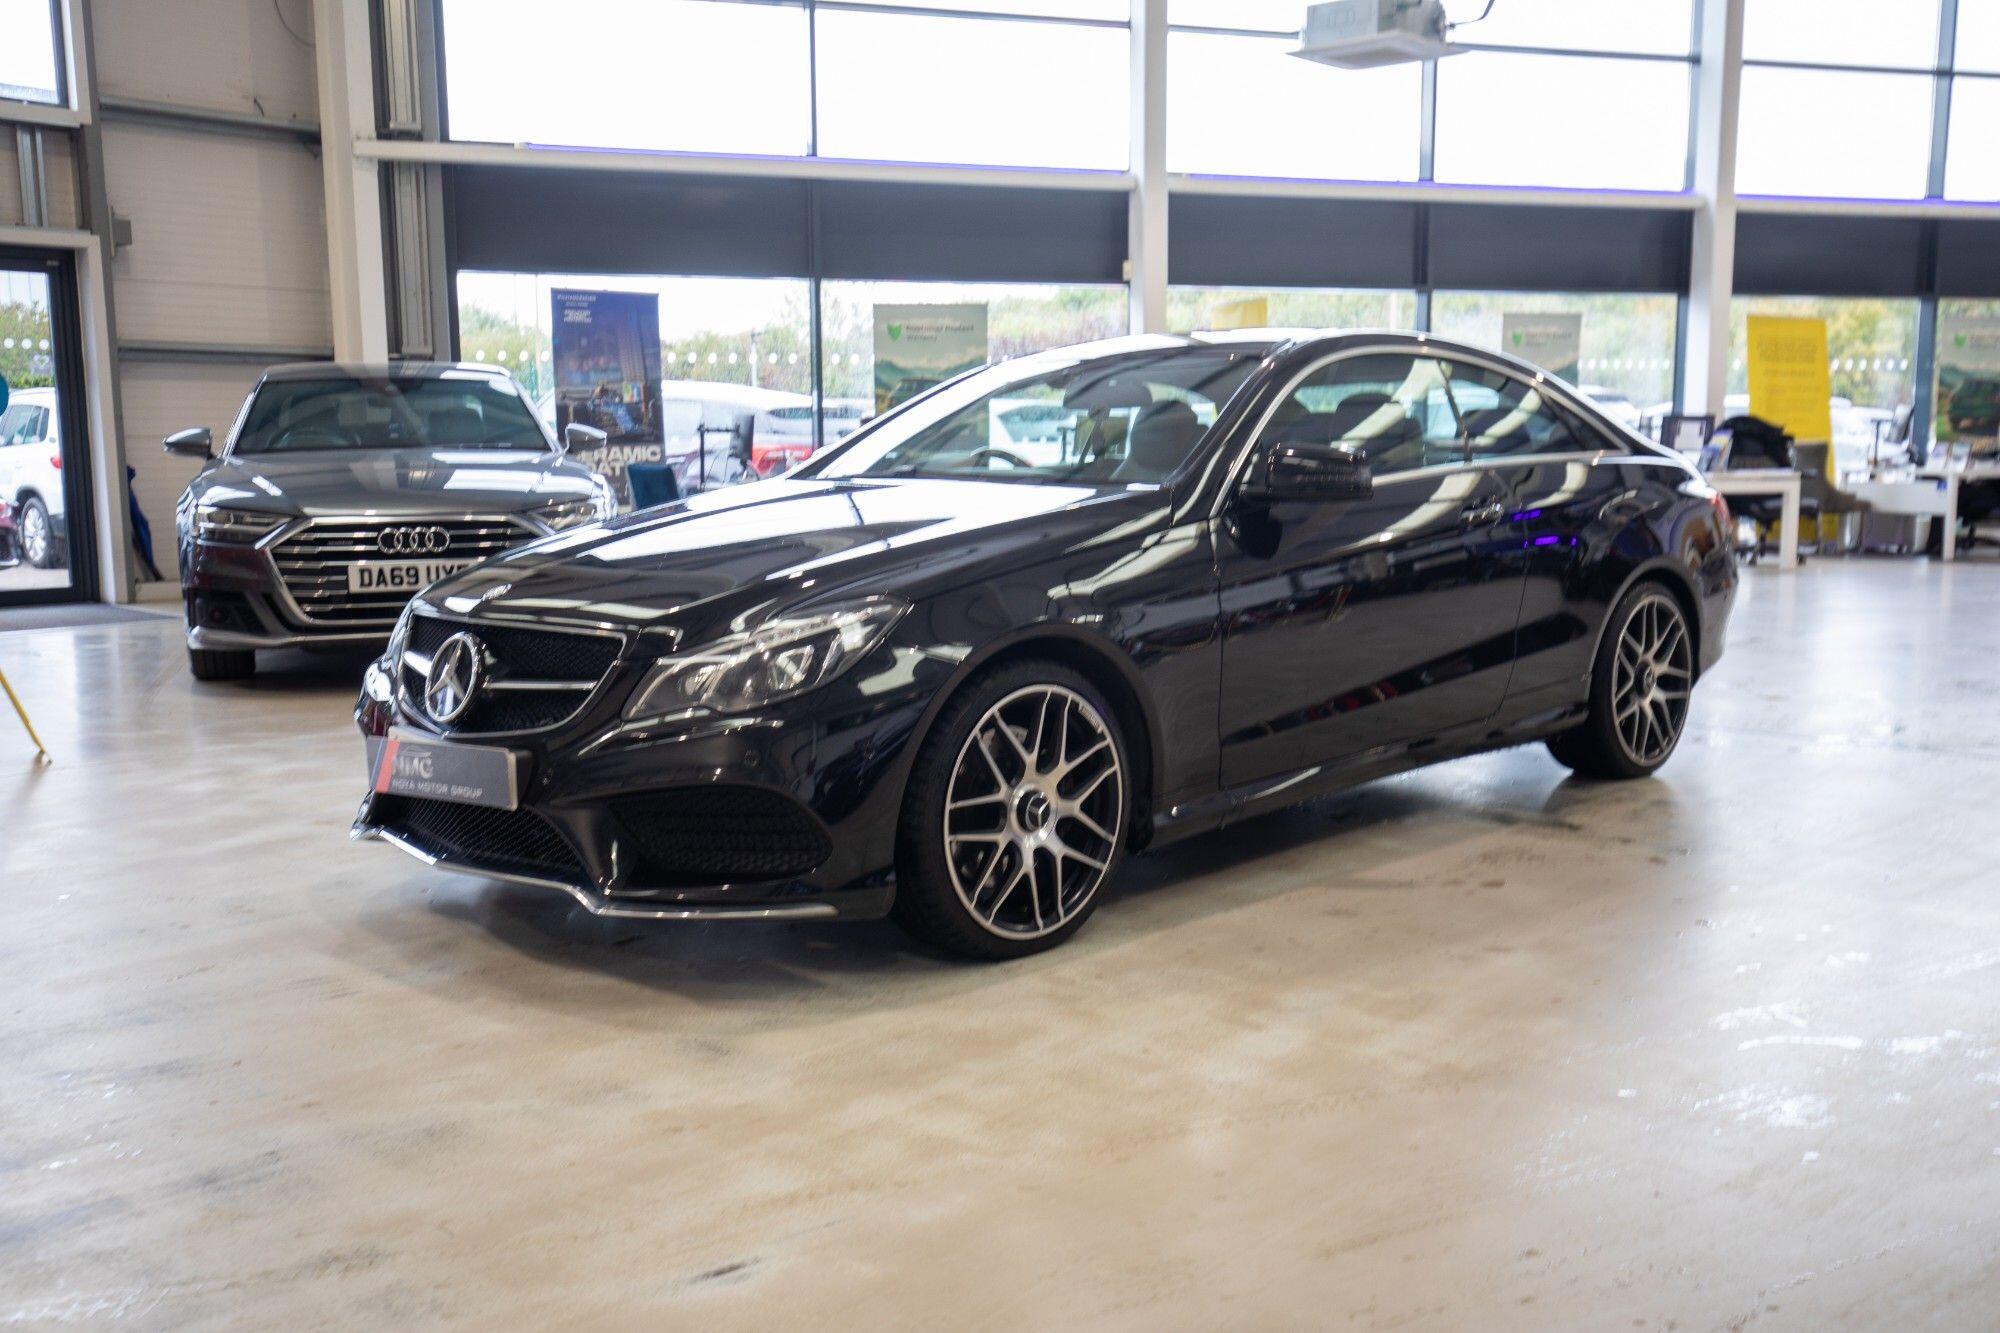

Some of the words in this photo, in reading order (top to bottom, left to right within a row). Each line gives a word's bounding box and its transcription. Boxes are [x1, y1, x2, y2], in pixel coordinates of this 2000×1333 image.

[359, 566, 420, 589] DA69
[418, 782, 449, 795] MOTOR
[450, 784, 483, 799] GROUP
